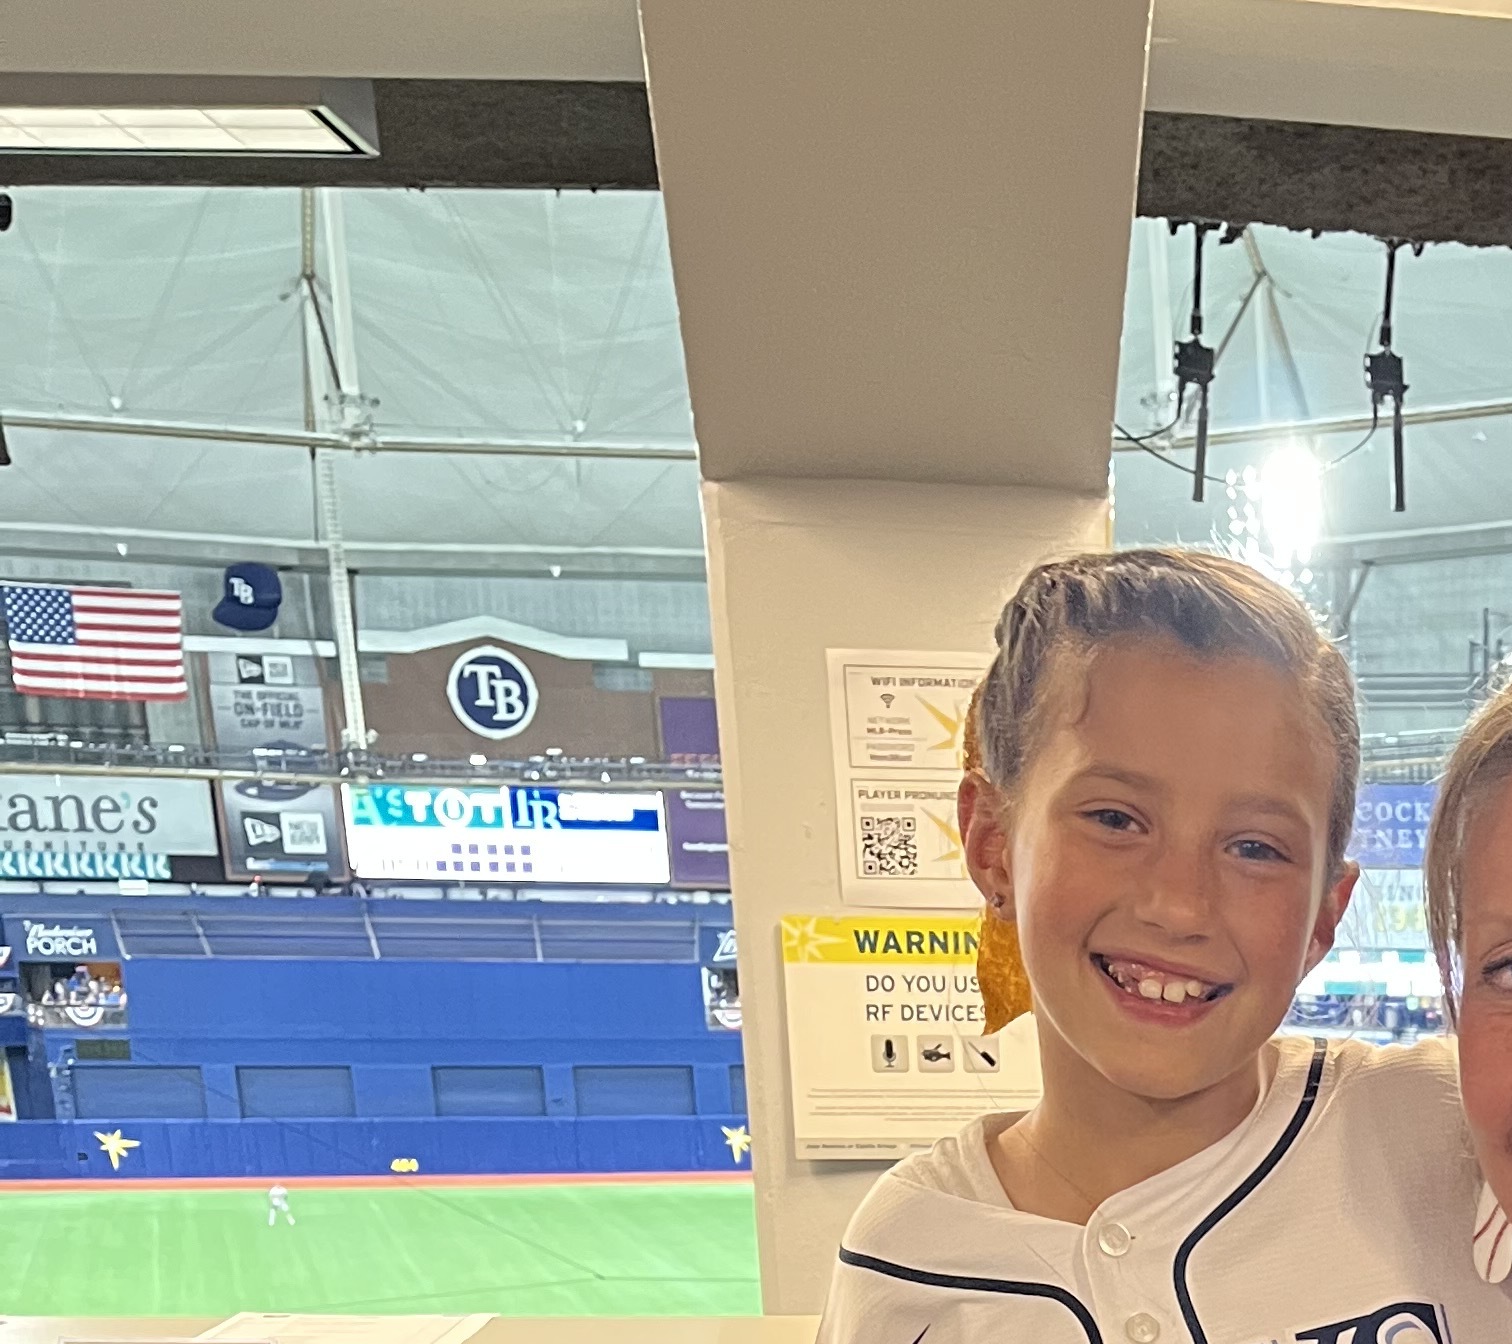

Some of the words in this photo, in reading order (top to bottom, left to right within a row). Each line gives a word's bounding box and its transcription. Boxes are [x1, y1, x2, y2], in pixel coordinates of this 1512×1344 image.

[463, 664, 525, 721] TB
[0, 792, 159, 834] ane's
[26, 937, 98, 956] PORCH
[866, 974, 896, 993] DO
[901, 974, 946, 993] YOU
[866, 1003, 894, 1021] RF
